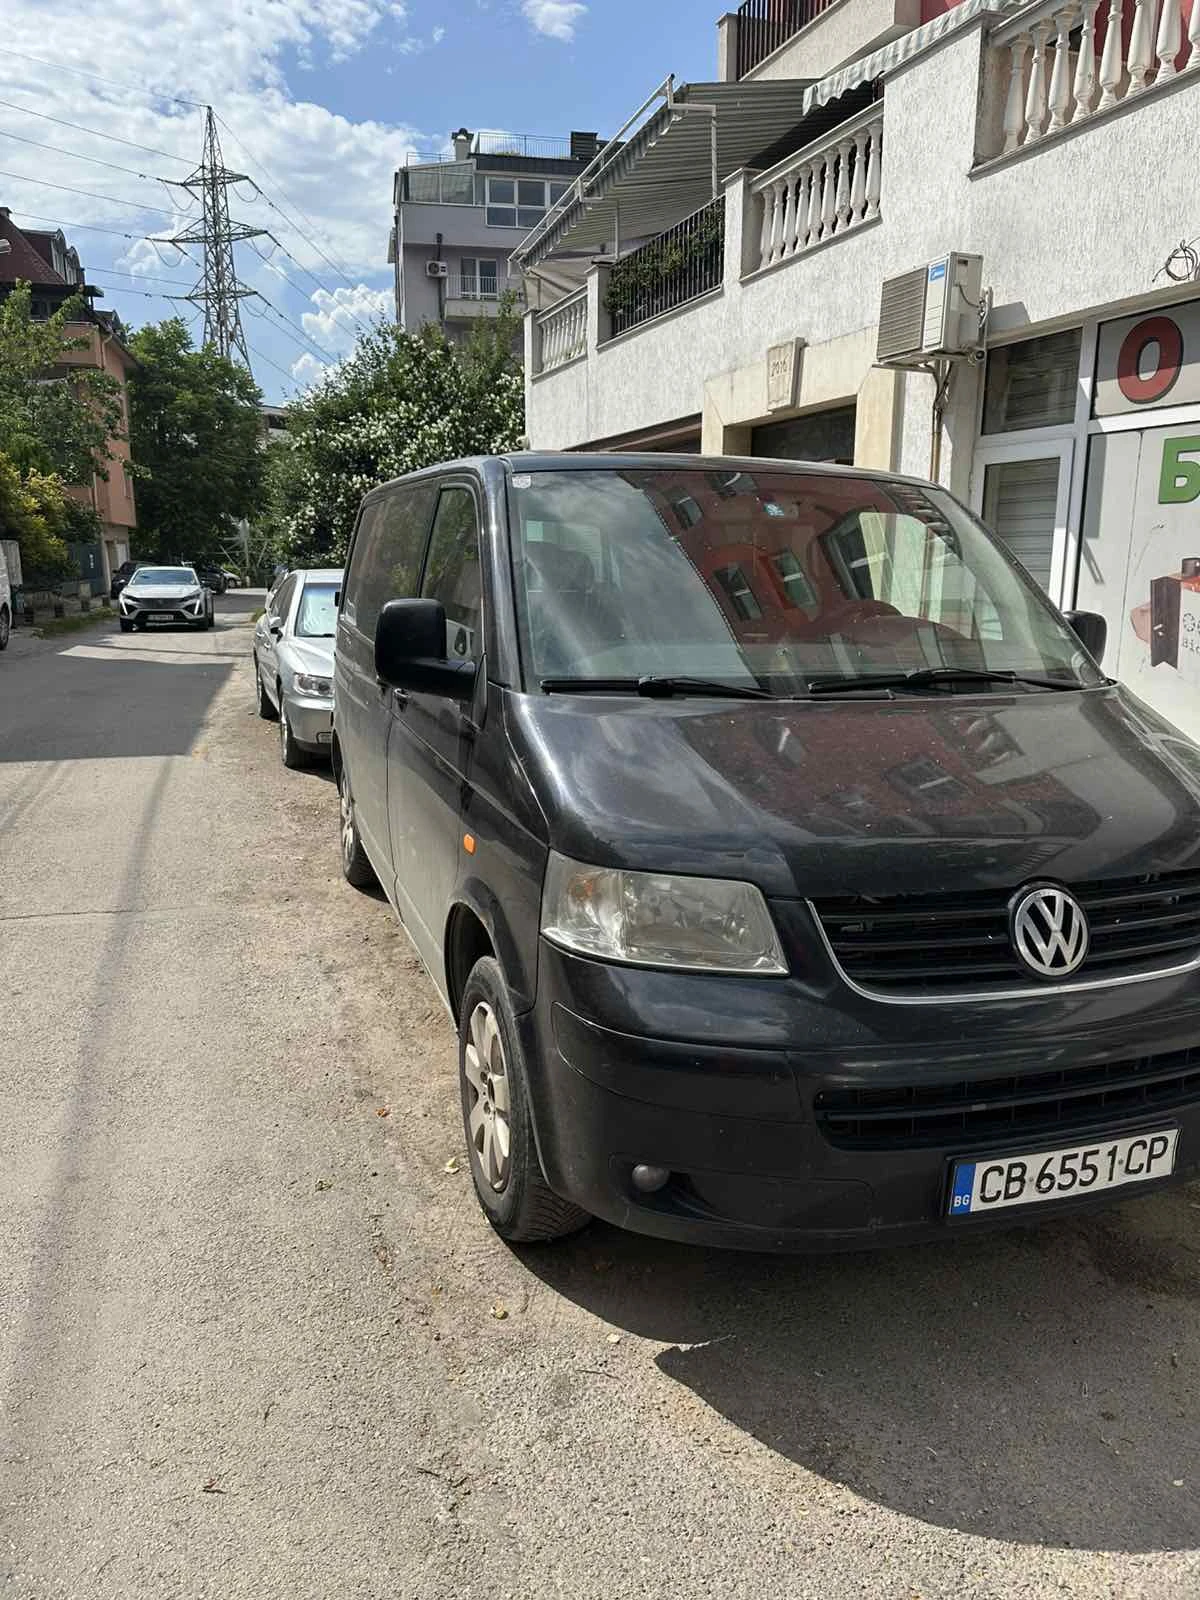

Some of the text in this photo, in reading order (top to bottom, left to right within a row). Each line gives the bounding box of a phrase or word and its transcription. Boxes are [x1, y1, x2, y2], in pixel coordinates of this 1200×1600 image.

[980, 1135, 1169, 1202] CB 6551 CP
[953, 1194, 970, 1208] BG
